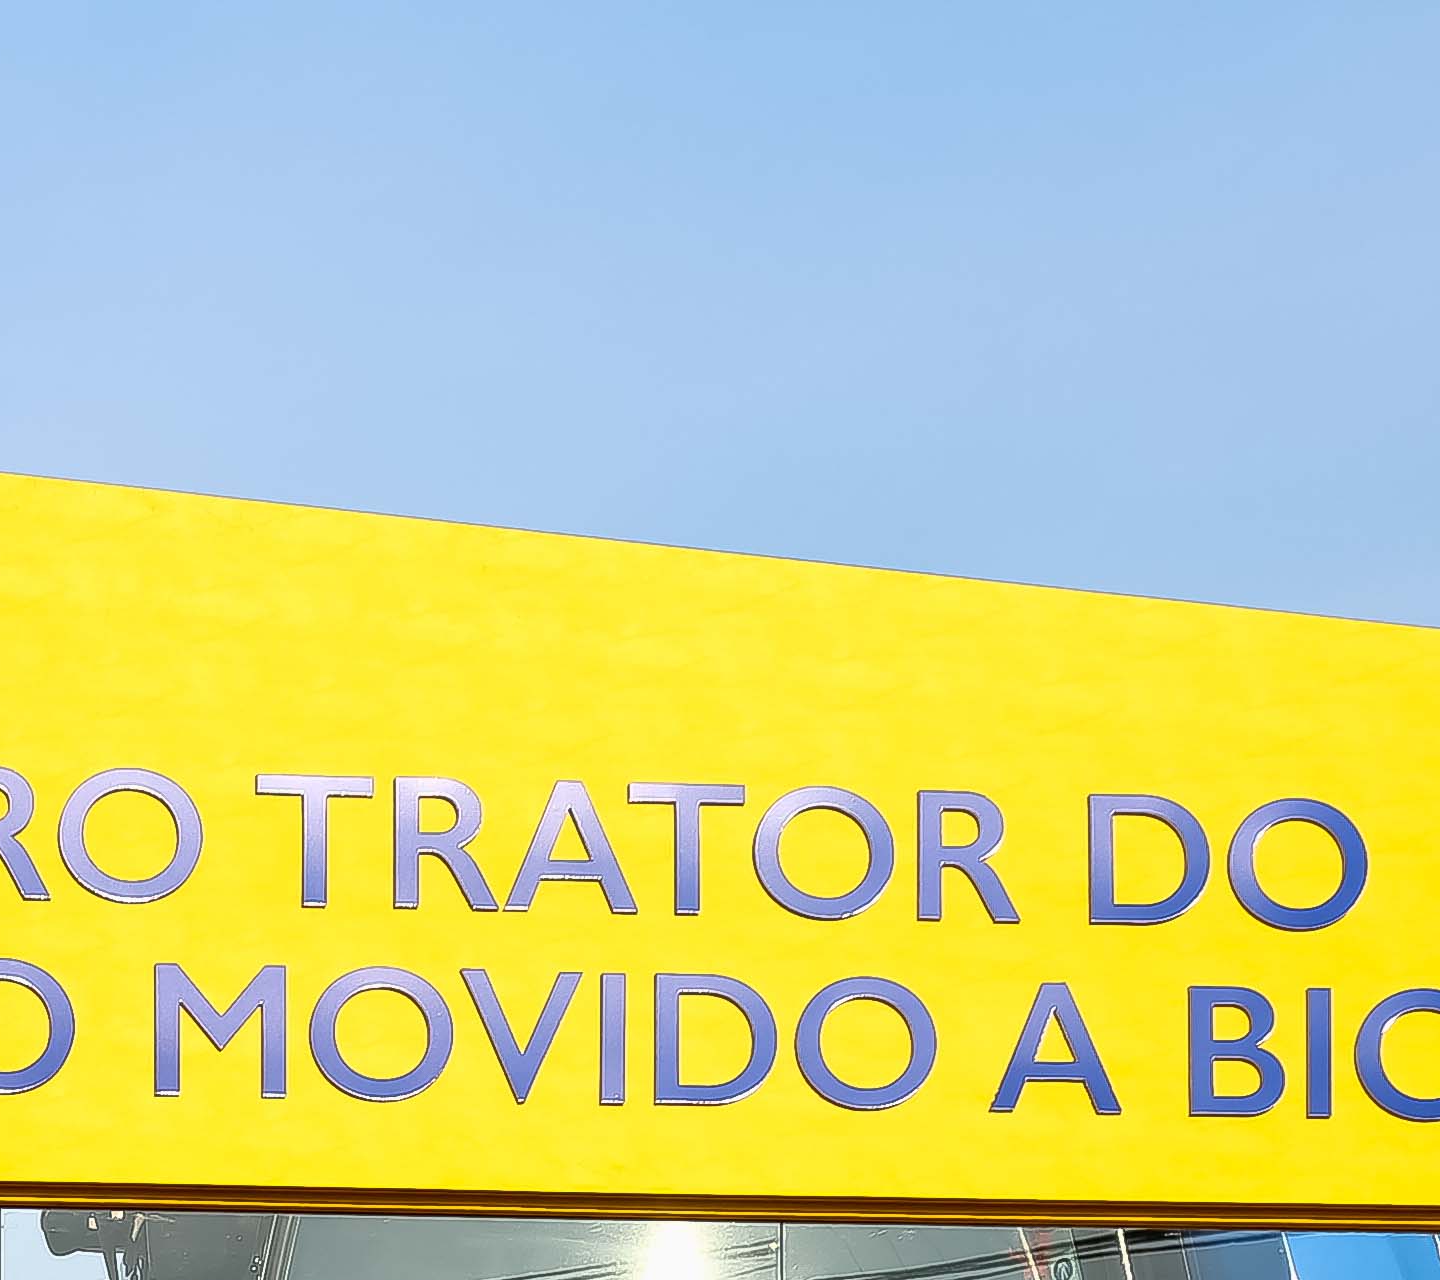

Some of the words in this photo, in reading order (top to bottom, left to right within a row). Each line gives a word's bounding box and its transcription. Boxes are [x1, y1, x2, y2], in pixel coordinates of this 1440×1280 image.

[252, 772, 1022, 925] TRATOR
[1087, 792, 1371, 933] DO
[152, 961, 940, 1112] MOVIDO
[988, 981, 1124, 1115] A
